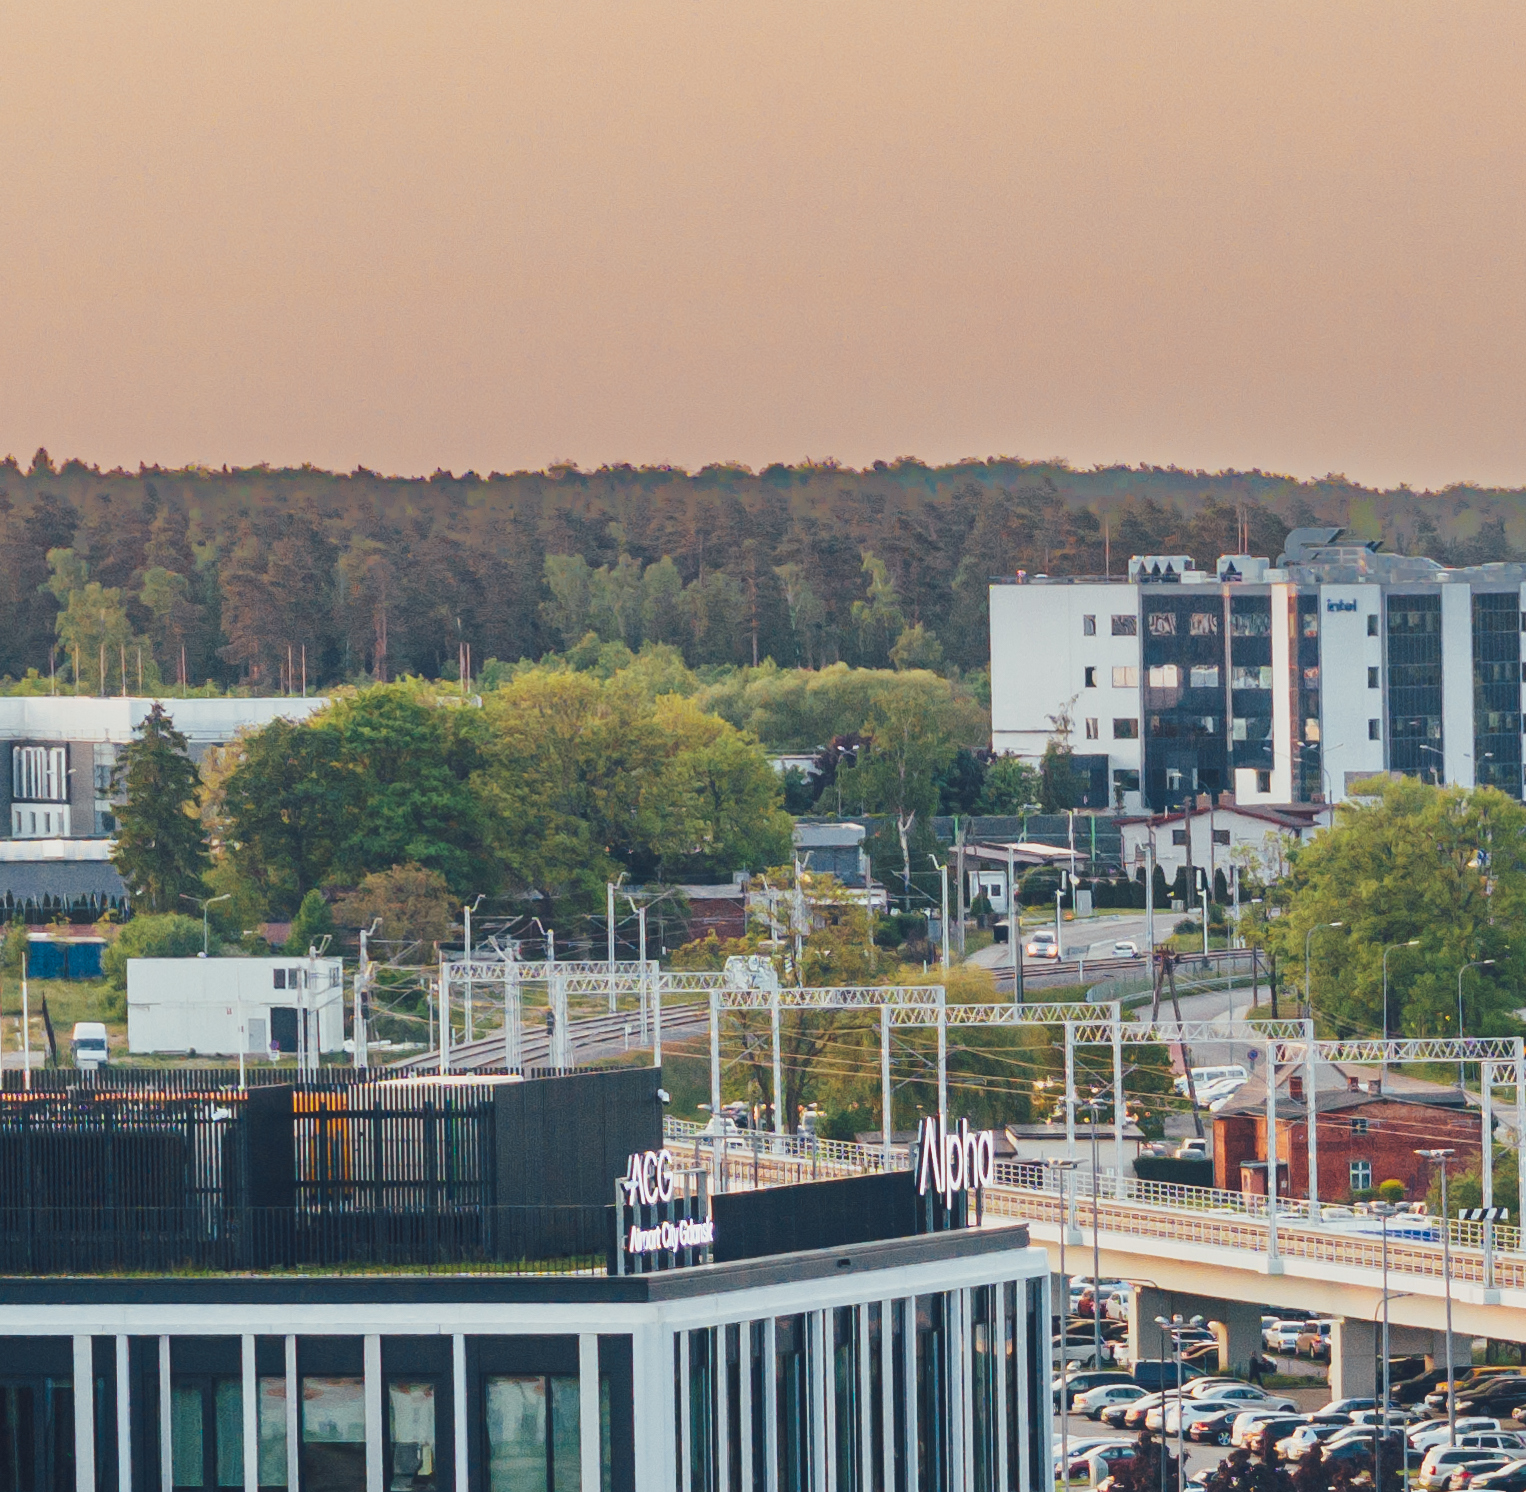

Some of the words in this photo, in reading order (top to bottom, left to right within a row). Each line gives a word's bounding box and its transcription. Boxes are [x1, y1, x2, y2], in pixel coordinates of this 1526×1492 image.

[629, 1149, 673, 1206] ACG
[919, 1114, 993, 1210] Alpha
[629, 1225, 661, 1253] Airport
